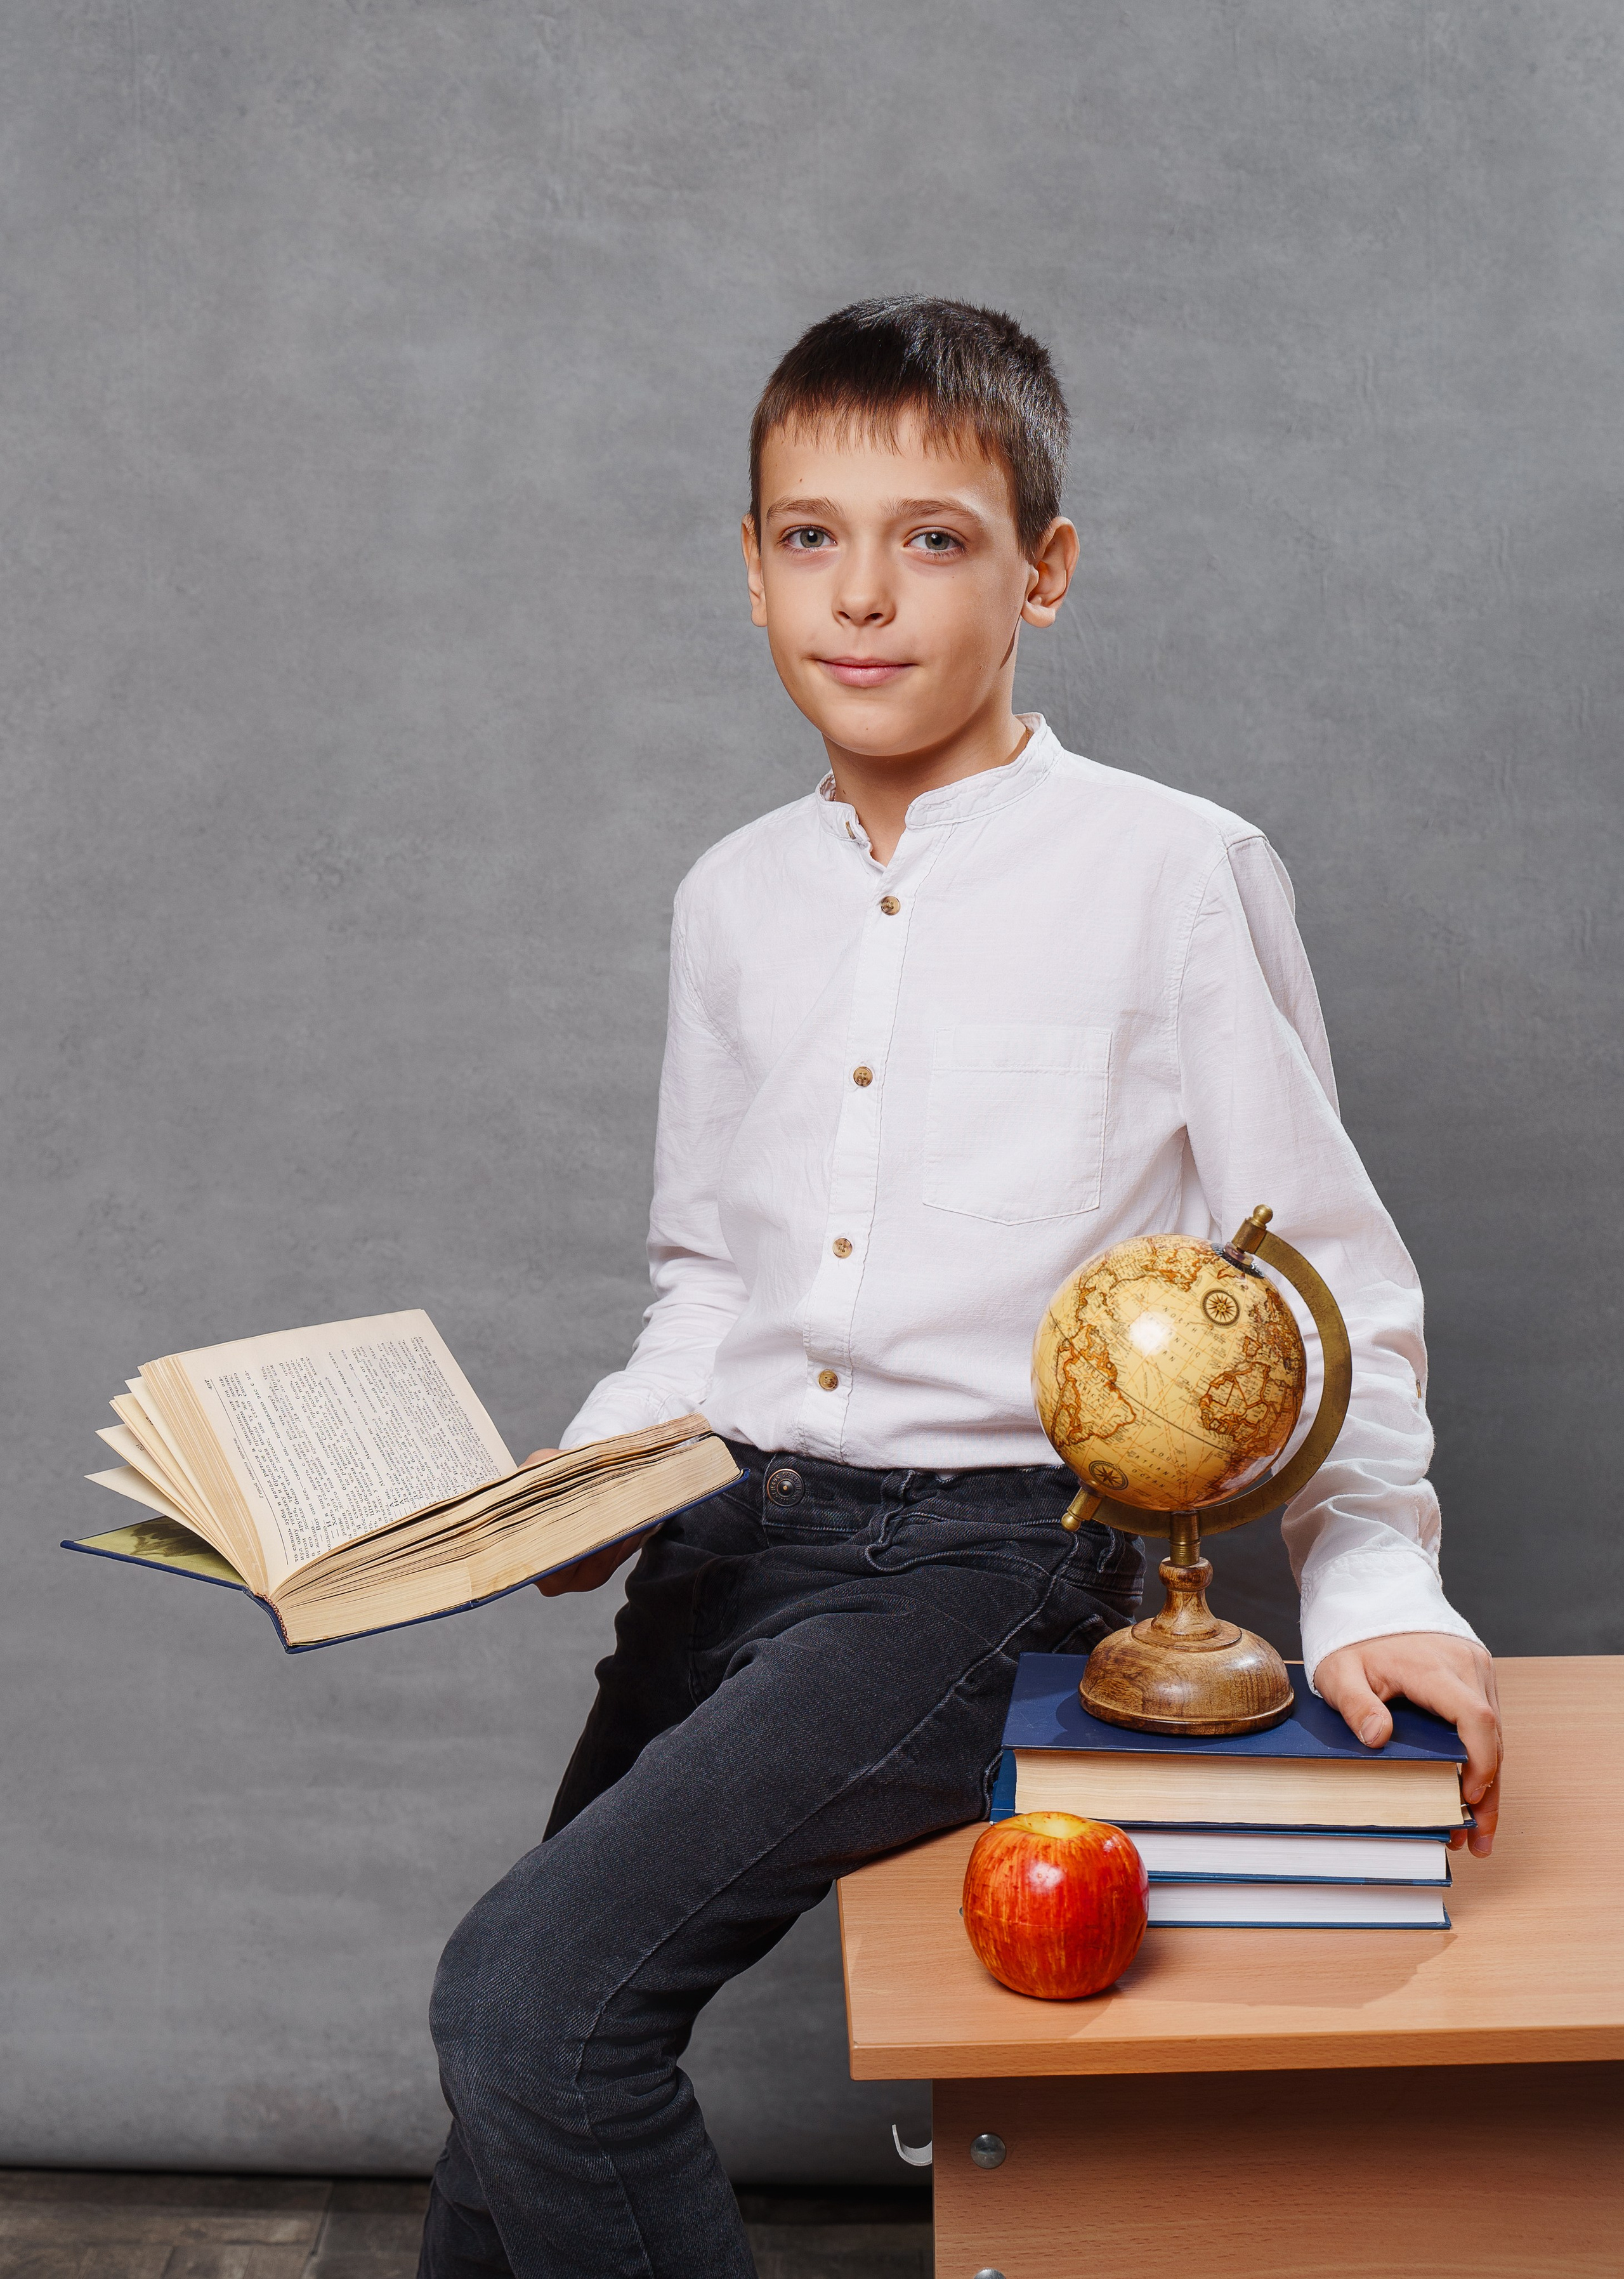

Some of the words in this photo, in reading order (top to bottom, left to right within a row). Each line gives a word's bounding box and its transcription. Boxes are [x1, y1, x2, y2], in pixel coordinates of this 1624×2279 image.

[1163, 1307, 1197, 1332] NORTH
[305, 1356, 318, 1376] холод-
[328, 1351, 339, 1368] сдать
[218, 1376, 226, 1386] вы-
[264, 1365, 280, 1390] Правда,
[289, 1360, 306, 1388] заклады-
[300, 1357, 317, 1387] готовился
[204, 1378, 213, 1391] 497
[233, 1372, 247, 1396] смешно
[287, 1381, 301, 1399] боясь,
[302, 1374, 315, 1393] время,
[325, 1376, 338, 1395] едете?
[228, 1400, 237, 1410] вот
[246, 1400, 258, 1418] стало
[301, 1395, 317, 1418] пришли
[304, 1390, 316, 1407] велел
[317, 1380, 344, 1426] принужденный,
[259, 1402, 281, 1438] поздравляю
[322, 1401, 340, 1429] казалось,
[322, 1412, 337, 1436] комнату
[341, 1407, 353, 1424] разве
[356, 1406, 369, 1425] видал,
[239, 1410, 259, 1446] презрением
[252, 1426, 265, 1445] имели
[257, 1422, 265, 1433] мне
[285, 1420, 298, 1438] Какое
[314, 1421, 327, 1440] Скоро
[135, 1443, 145, 1452] 701
[232, 1437, 245, 1459] времени
[314, 1431, 331, 1458] поскорее
[342, 1428, 358, 1455] какой-то
[351, 1426, 371, 1460] Максимыч,
[263, 1448, 278, 1472] десятая
[296, 1442, 315, 1474] печатайте.
[326, 1443, 346, 1475] раскаялся.
[332, 1443, 348, 1469] тронется
[339, 1445, 351, 1464] вошел
[372, 1436, 393, 1471] коменданта
[384, 1449, 402, 1476] казенные
[1151, 1448, 1186, 1468] SOUTH
[244, 1461, 255, 1481] нашего
[254, 1455, 268, 1476] рыться
[265, 1464, 279, 1487] бросил
[278, 1466, 291, 1485] что-то
[287, 1459, 301, 1480] сказал
[315, 1456, 327, 1475] одной
[369, 1462, 385, 1487] Максим
[1135, 1455, 1188, 1485] ATLANTIC
[266, 1480, 278, 1498] начал
[304, 1469, 318, 1490] делать
[314, 1476, 327, 1500] газетах
[332, 1468, 347, 1490] бумаги
[358, 1471, 373, 1496] надевал
[1132, 1469, 1165, 1488] OCEAN
[253, 1482, 264, 1499] Герой
[280, 1481, 293, 1502] третья
[288, 1488, 299, 1505] было
[332, 1490, 344, 1509] долго
[350, 1467, 374, 1516] Штабс-капитан
[353, 1485, 364, 1502] через
[388, 1487, 400, 1506] Нет-с.
[400, 1478, 417, 1508] кой-какие
[279, 1508, 290, 1525] зубы
[280, 1495, 296, 1525] тетрадку
[345, 1493, 358, 1519] схватил
[292, 1507, 304, 1532] другая,
[298, 1507, 310, 1530] досаде
[337, 1516, 346, 1536] разве
[287, 1528, 296, 1551] сквозь
[293, 1528, 301, 1544] одну
